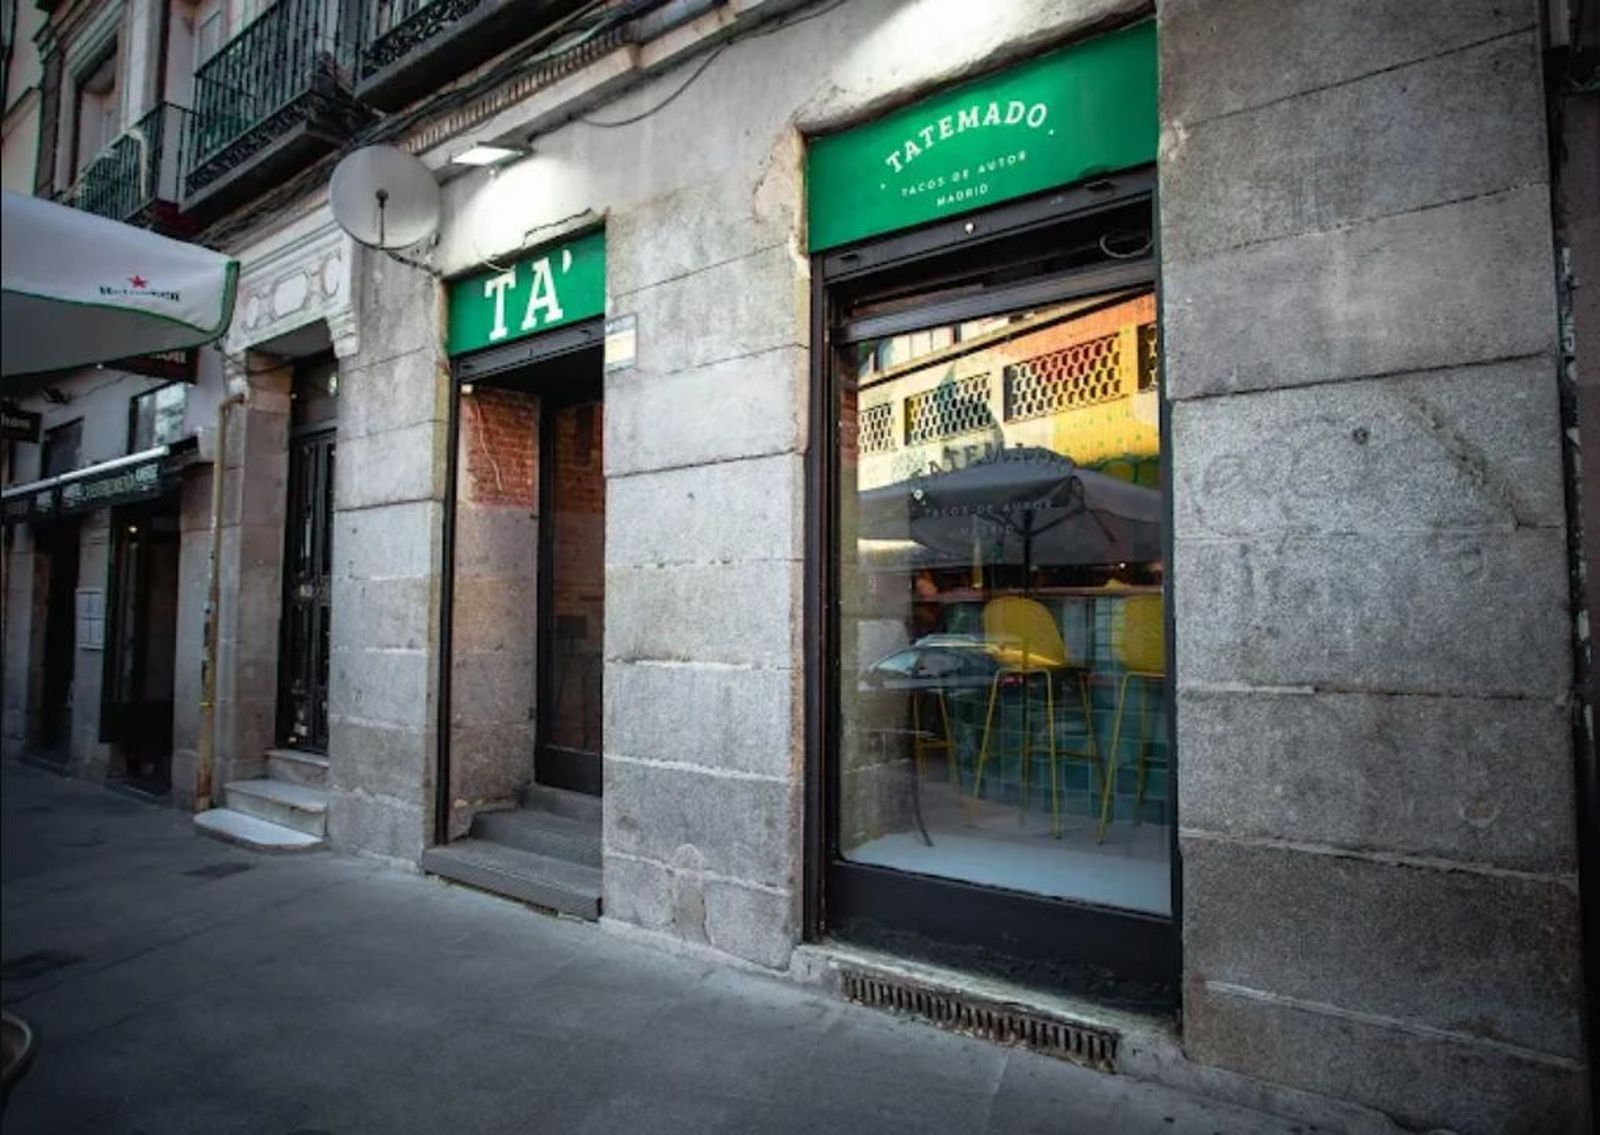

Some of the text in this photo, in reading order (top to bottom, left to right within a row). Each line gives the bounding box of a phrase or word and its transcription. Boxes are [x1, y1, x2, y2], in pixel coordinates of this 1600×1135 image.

[885, 100, 1048, 173] TATEMADO
[901, 151, 1028, 198] TACOS DE AUTOR
[936, 183, 990, 208] MADRID
